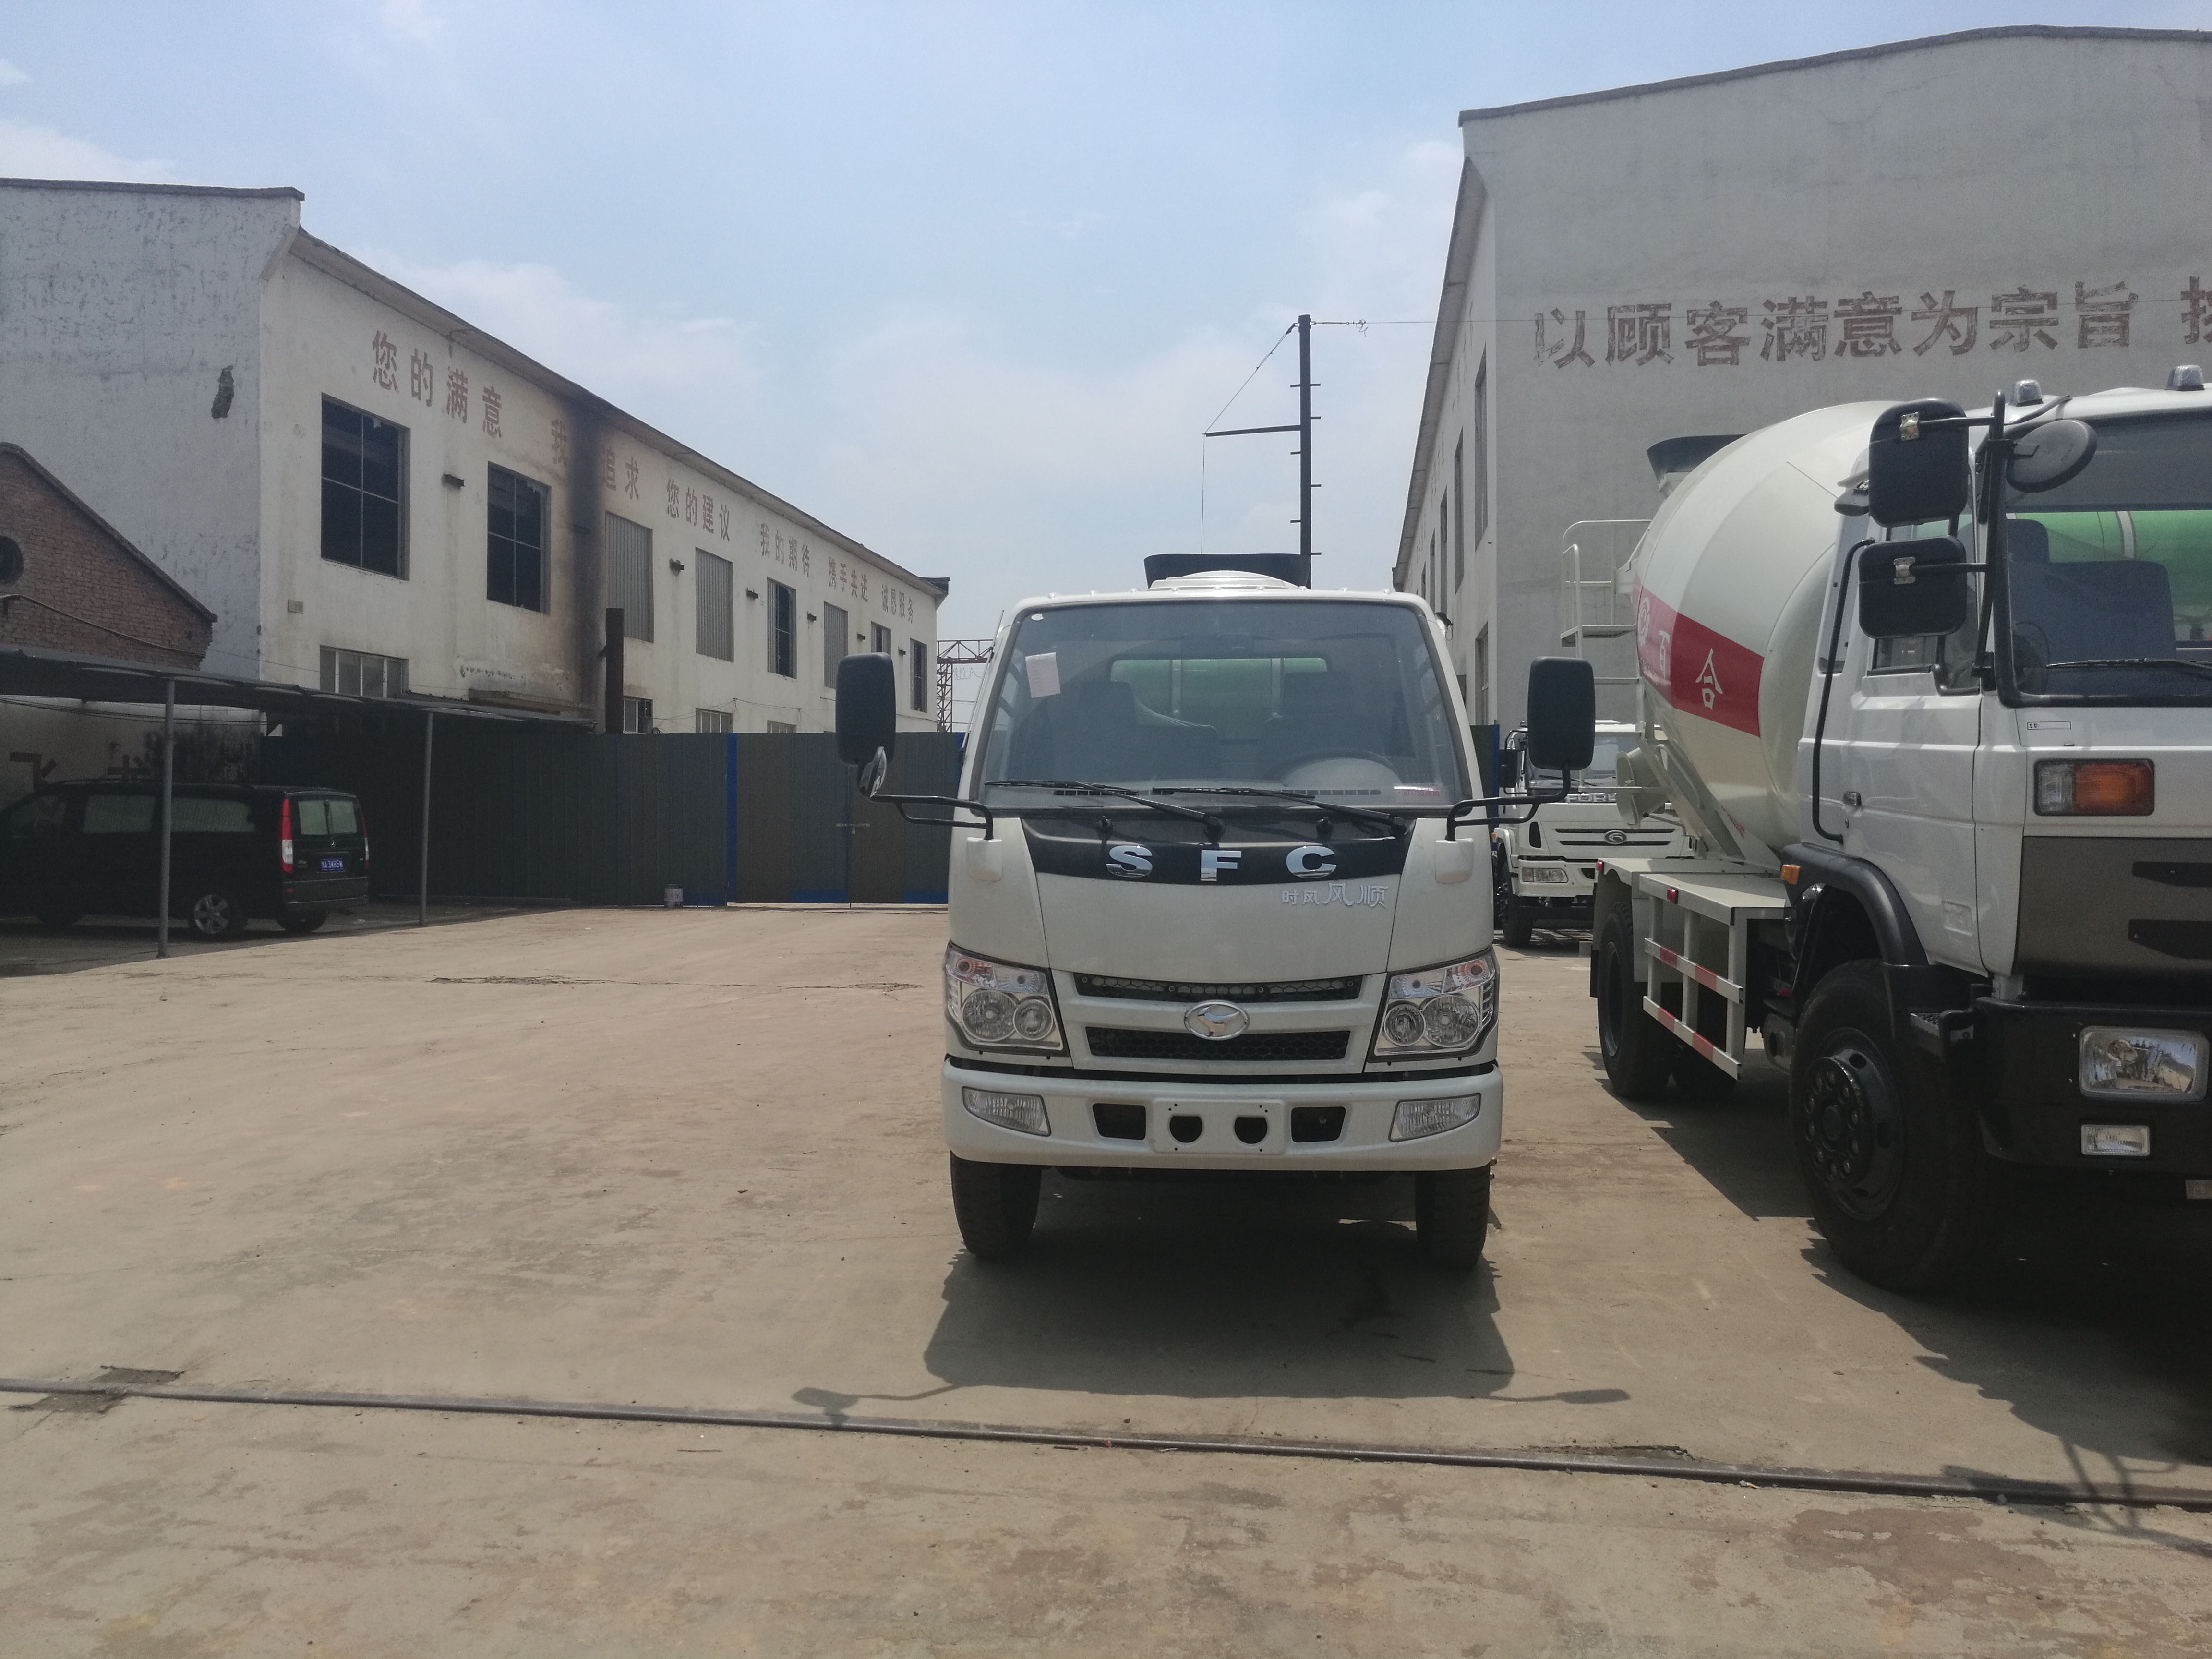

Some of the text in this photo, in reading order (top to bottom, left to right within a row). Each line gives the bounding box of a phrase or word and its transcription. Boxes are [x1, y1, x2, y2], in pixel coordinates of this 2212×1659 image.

[1533, 280, 2138, 369] 以顾客满意为宗旨
[372, 330, 502, 438] 您的满意
[667, 479, 730, 542] 您的建议
[760, 523, 810, 577] 我的期待
[829, 556, 868, 602] 携手共进
[881, 585, 914, 623] 诚恳服务
[1106, 845, 1336, 882] SFC
